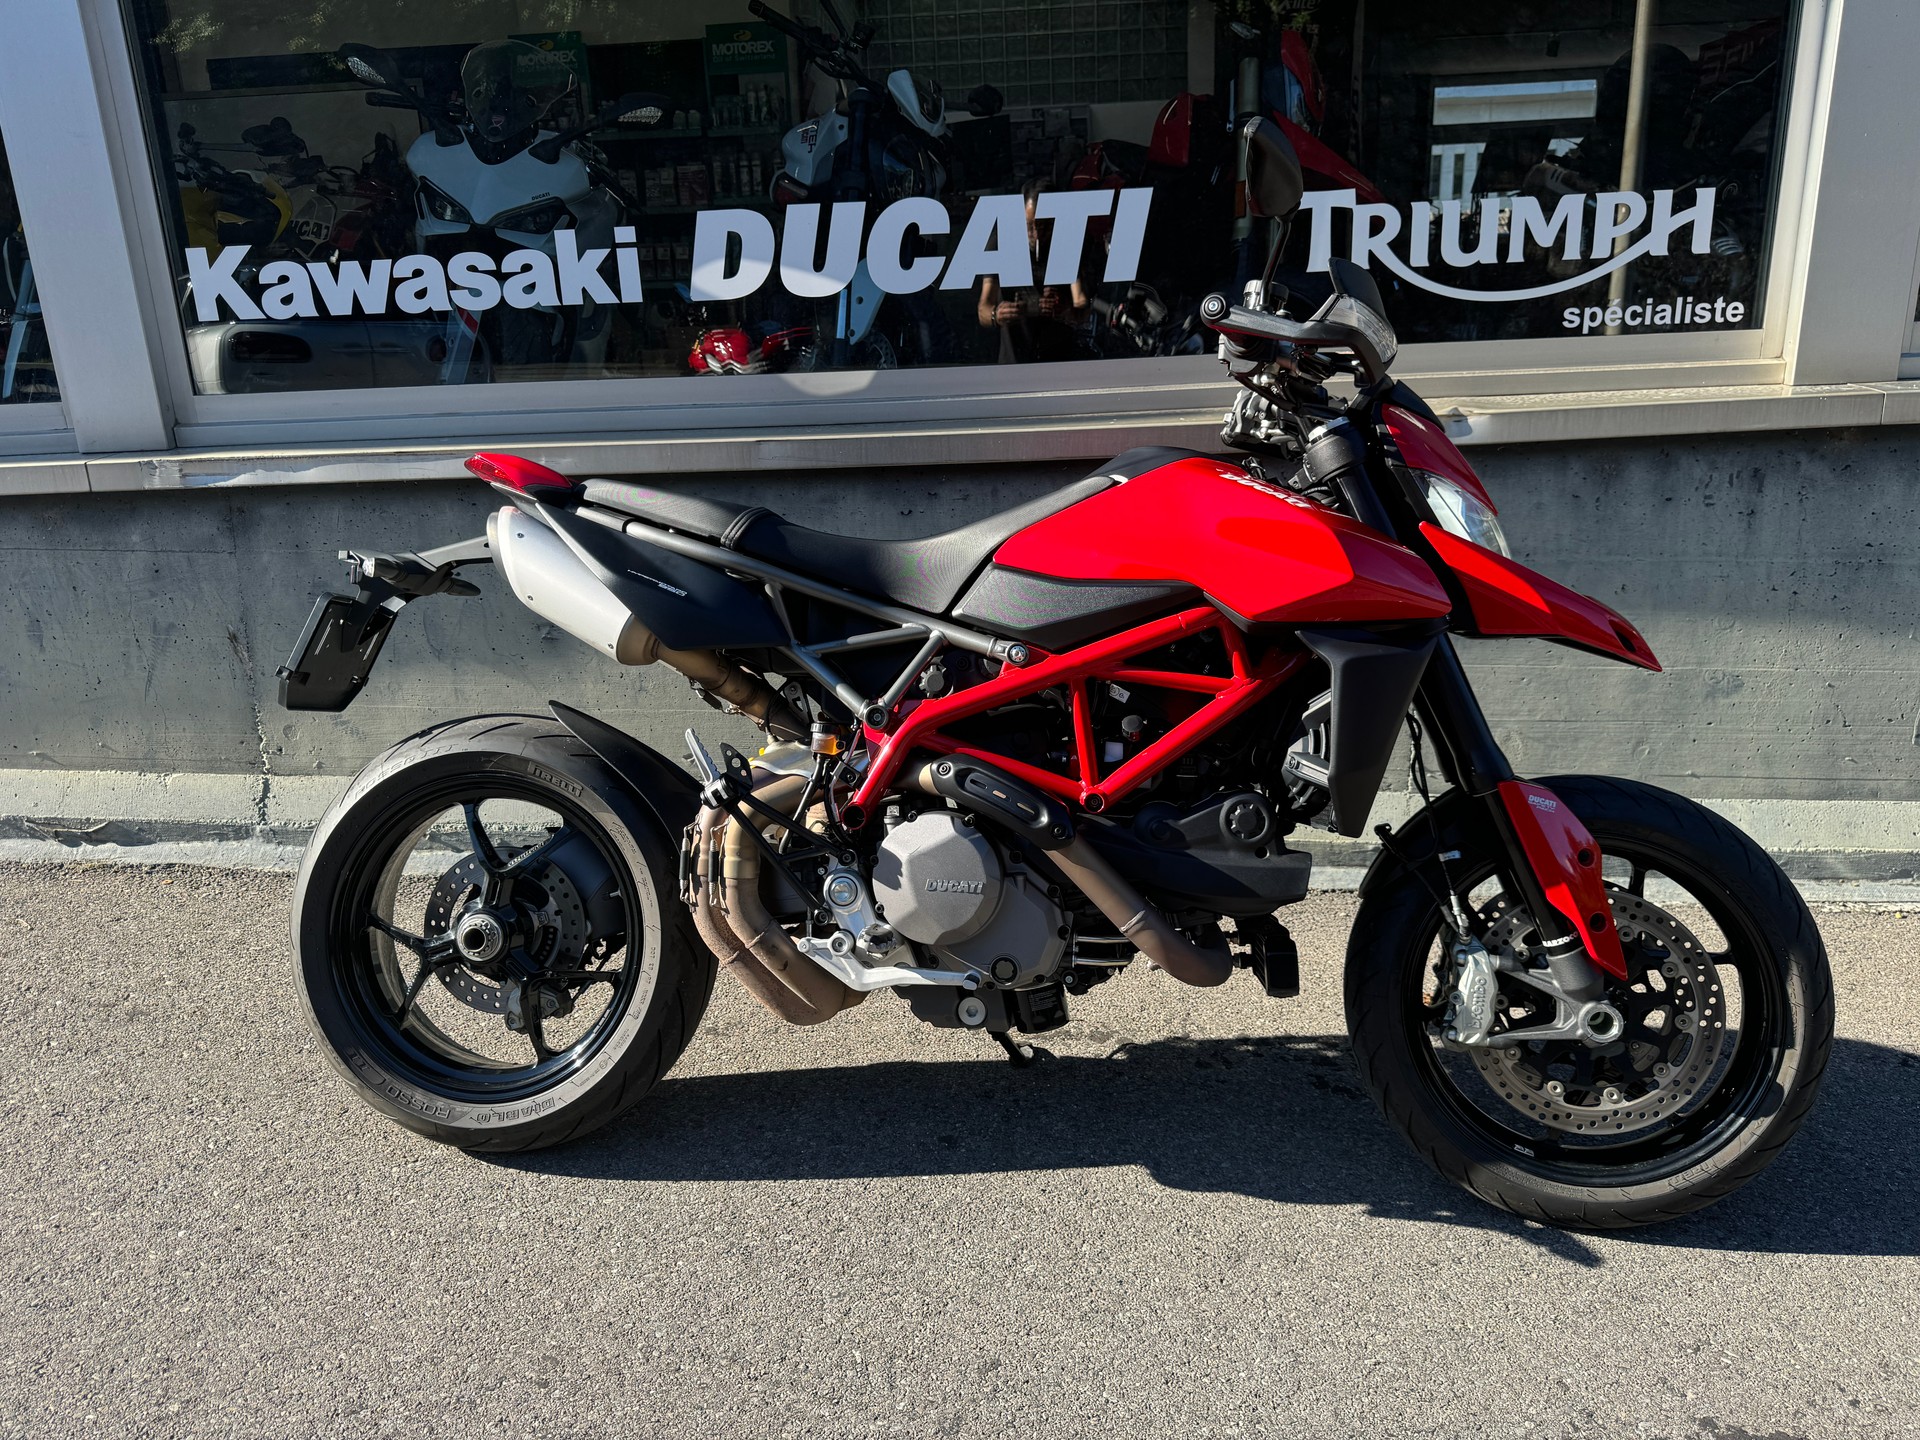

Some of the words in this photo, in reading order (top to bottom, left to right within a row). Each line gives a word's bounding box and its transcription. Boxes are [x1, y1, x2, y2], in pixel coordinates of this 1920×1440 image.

[711, 40, 776, 56] MOTOREX
[689, 187, 1154, 302] DUCATI
[1299, 187, 1717, 302] TRIUMPH
[185, 226, 643, 322] Kawasaki
[1562, 296, 1745, 335] spécialiste
[1528, 794, 1557, 808] DUCATI
[925, 878, 984, 895] DUCATI
[1468, 975, 1487, 1029] brembo
[386, 1085, 452, 1119] ROSSO
[476, 1096, 557, 1124] DIABLO
